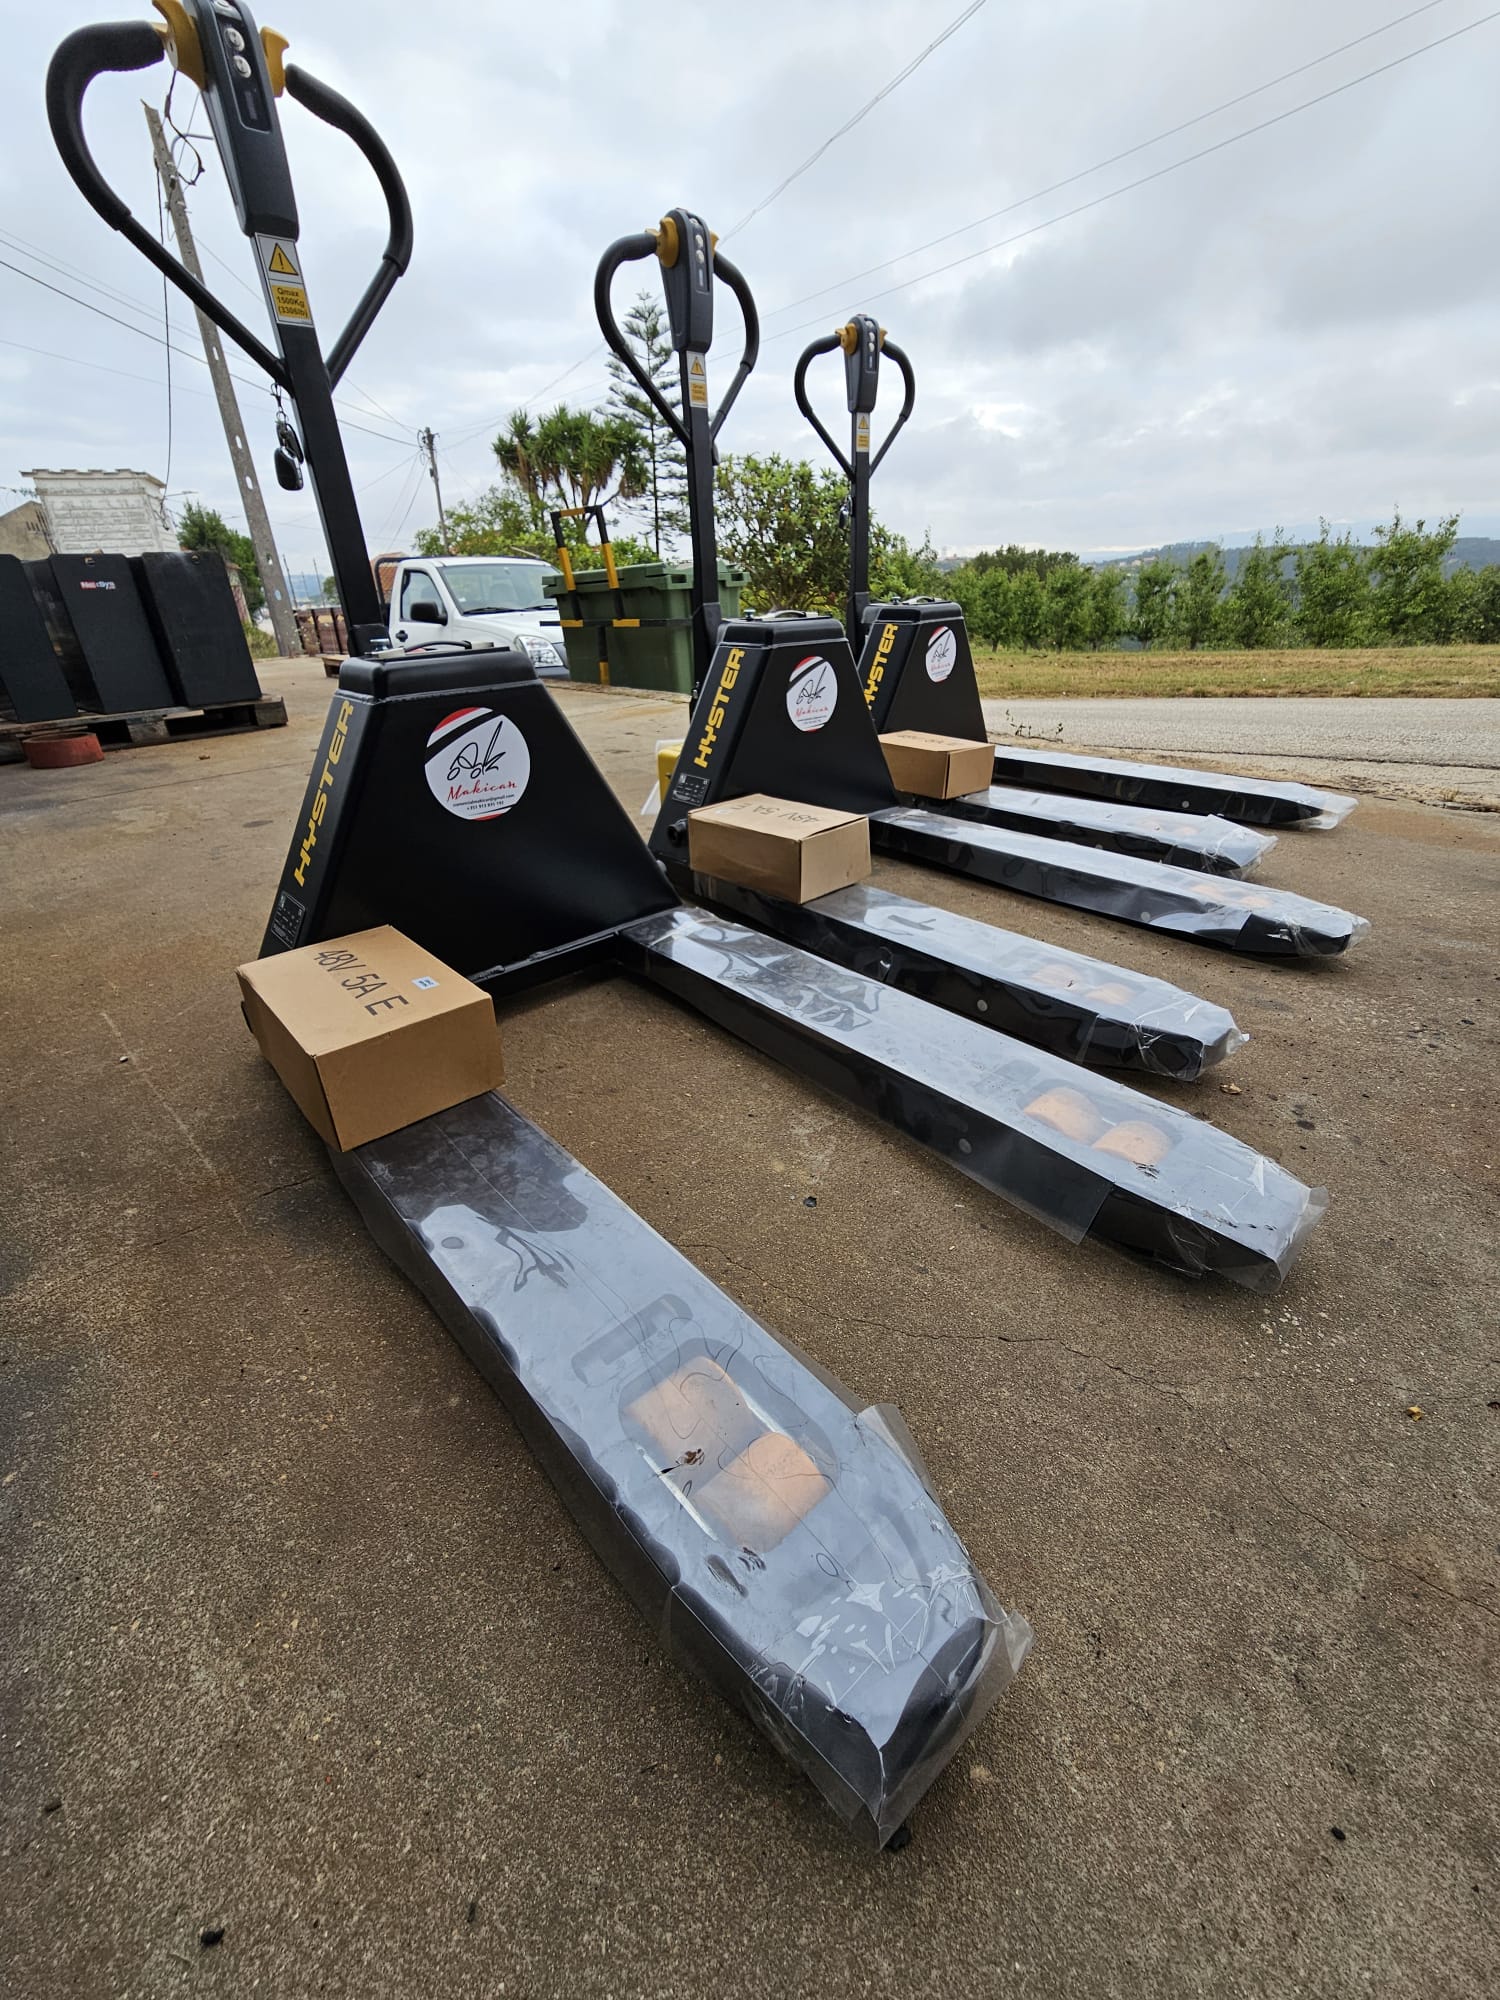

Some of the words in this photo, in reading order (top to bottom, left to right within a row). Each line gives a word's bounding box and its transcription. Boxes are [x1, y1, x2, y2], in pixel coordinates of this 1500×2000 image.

[277, 288, 299, 297] Qmax
[277, 296, 305, 308] 1500Kg
[693, 647, 746, 769] HYSTER
[293, 700, 354, 887] HYSTER
[447, 779, 518, 802] Makican
[752, 805, 779, 815] 5A
[778, 811, 820, 823] 48V
[313, 949, 367, 972] 48V
[341, 973, 388, 999] 5A
[364, 995, 410, 1017] E
